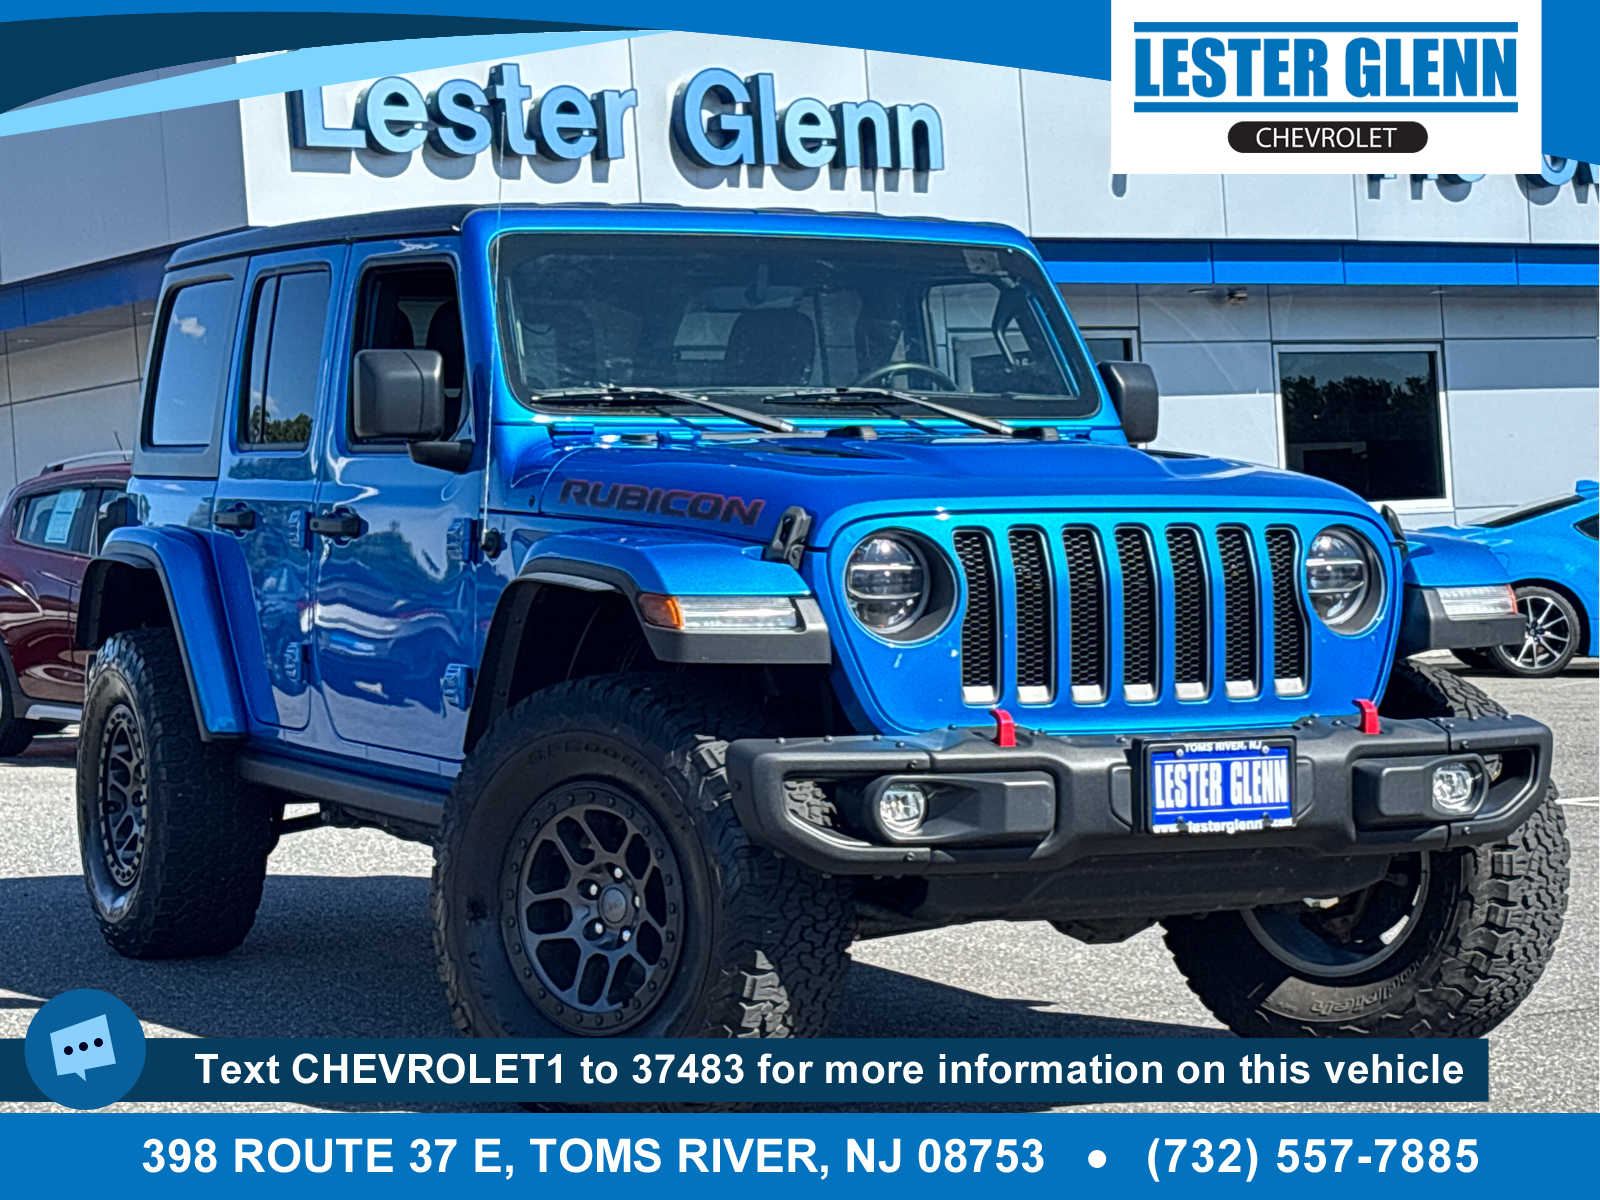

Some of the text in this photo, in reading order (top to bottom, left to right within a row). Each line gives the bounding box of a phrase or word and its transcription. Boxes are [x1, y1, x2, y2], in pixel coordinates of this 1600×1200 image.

[289, 62, 945, 171] Lester Glenn
[559, 479, 766, 526] RUBICON
[1184, 742, 1213, 753] TOMS
[1248, 740, 1262, 750] NJ
[1154, 759, 1288, 809] LESTER GLENN
[1187, 818, 1263, 834] lesterglenn
